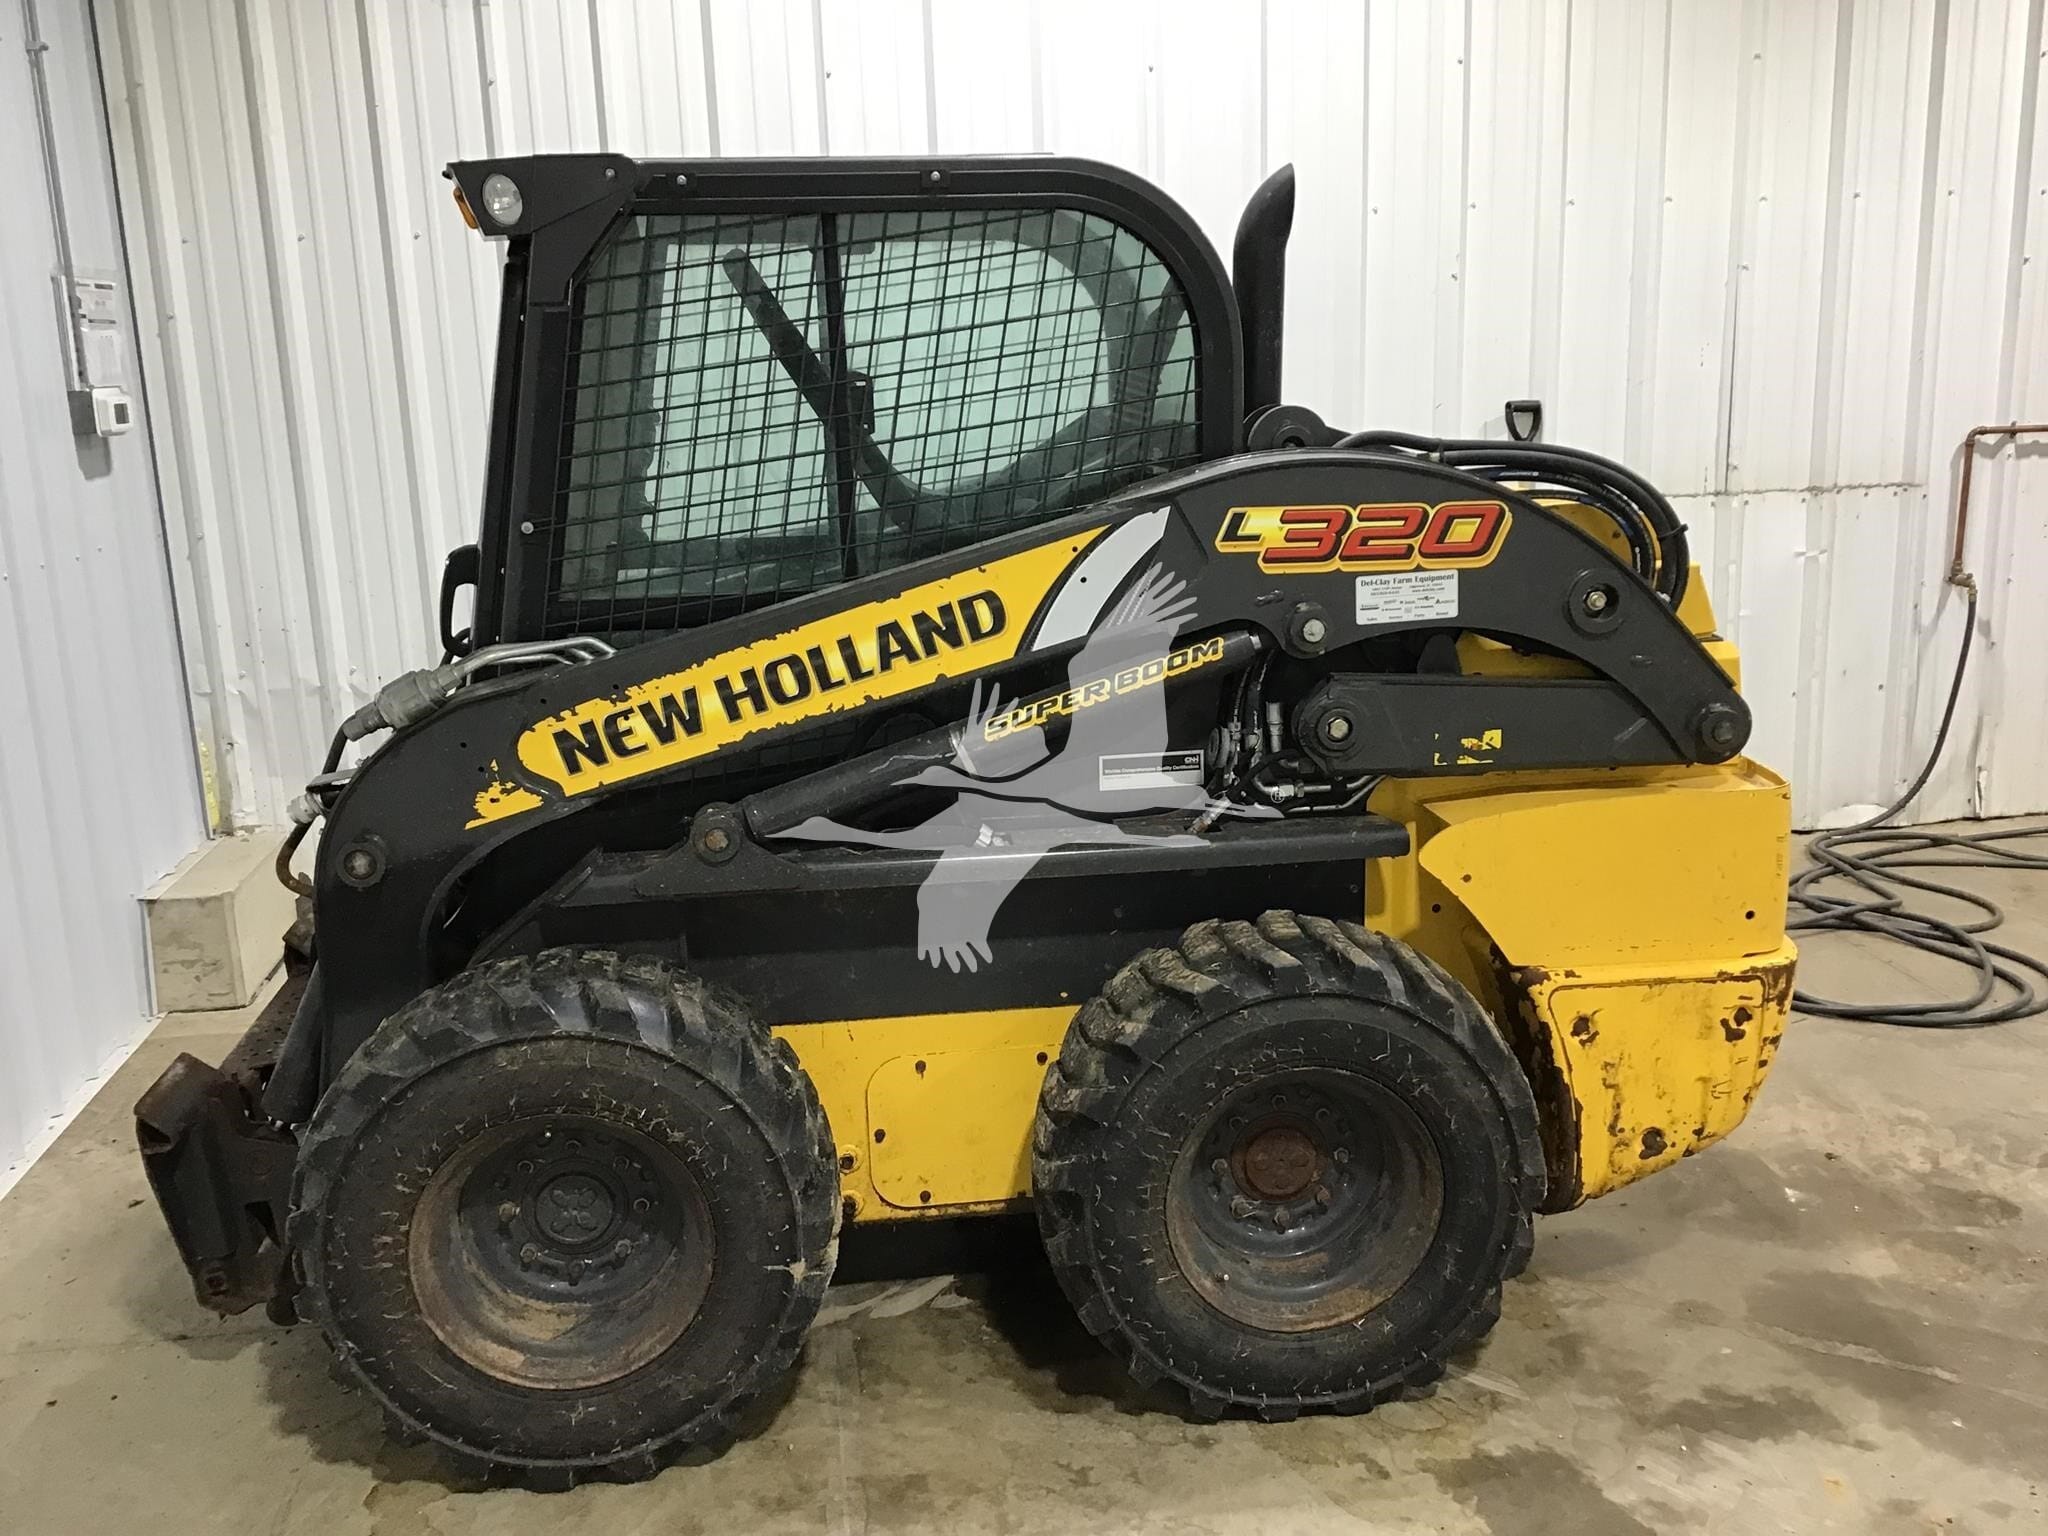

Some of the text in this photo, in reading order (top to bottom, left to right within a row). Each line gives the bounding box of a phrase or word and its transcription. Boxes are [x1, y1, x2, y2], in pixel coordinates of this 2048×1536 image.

[1217, 502, 1509, 570] L320
[1393, 576, 1412, 584] Farm
[1415, 574, 1454, 582] Equipment
[552, 589, 1008, 776] NEW HOLLAND
[984, 637, 1225, 742] SUPER BOOM
